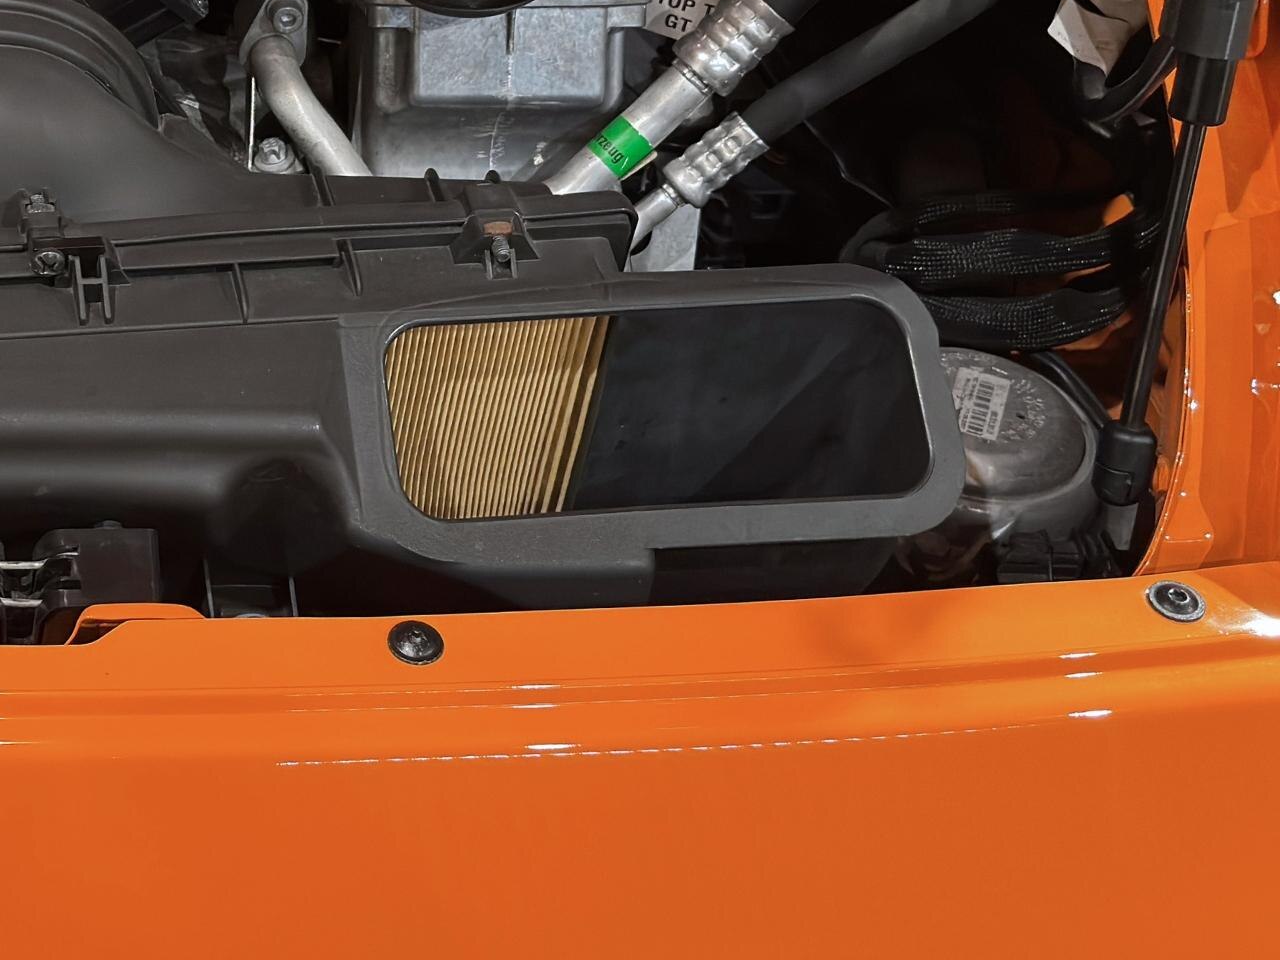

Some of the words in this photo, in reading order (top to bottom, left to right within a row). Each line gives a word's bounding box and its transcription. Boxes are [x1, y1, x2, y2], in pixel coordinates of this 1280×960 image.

[704, 3, 717, 17] T
[664, 14, 693, 32] GT
[597, 135, 624, 164] rzeug
